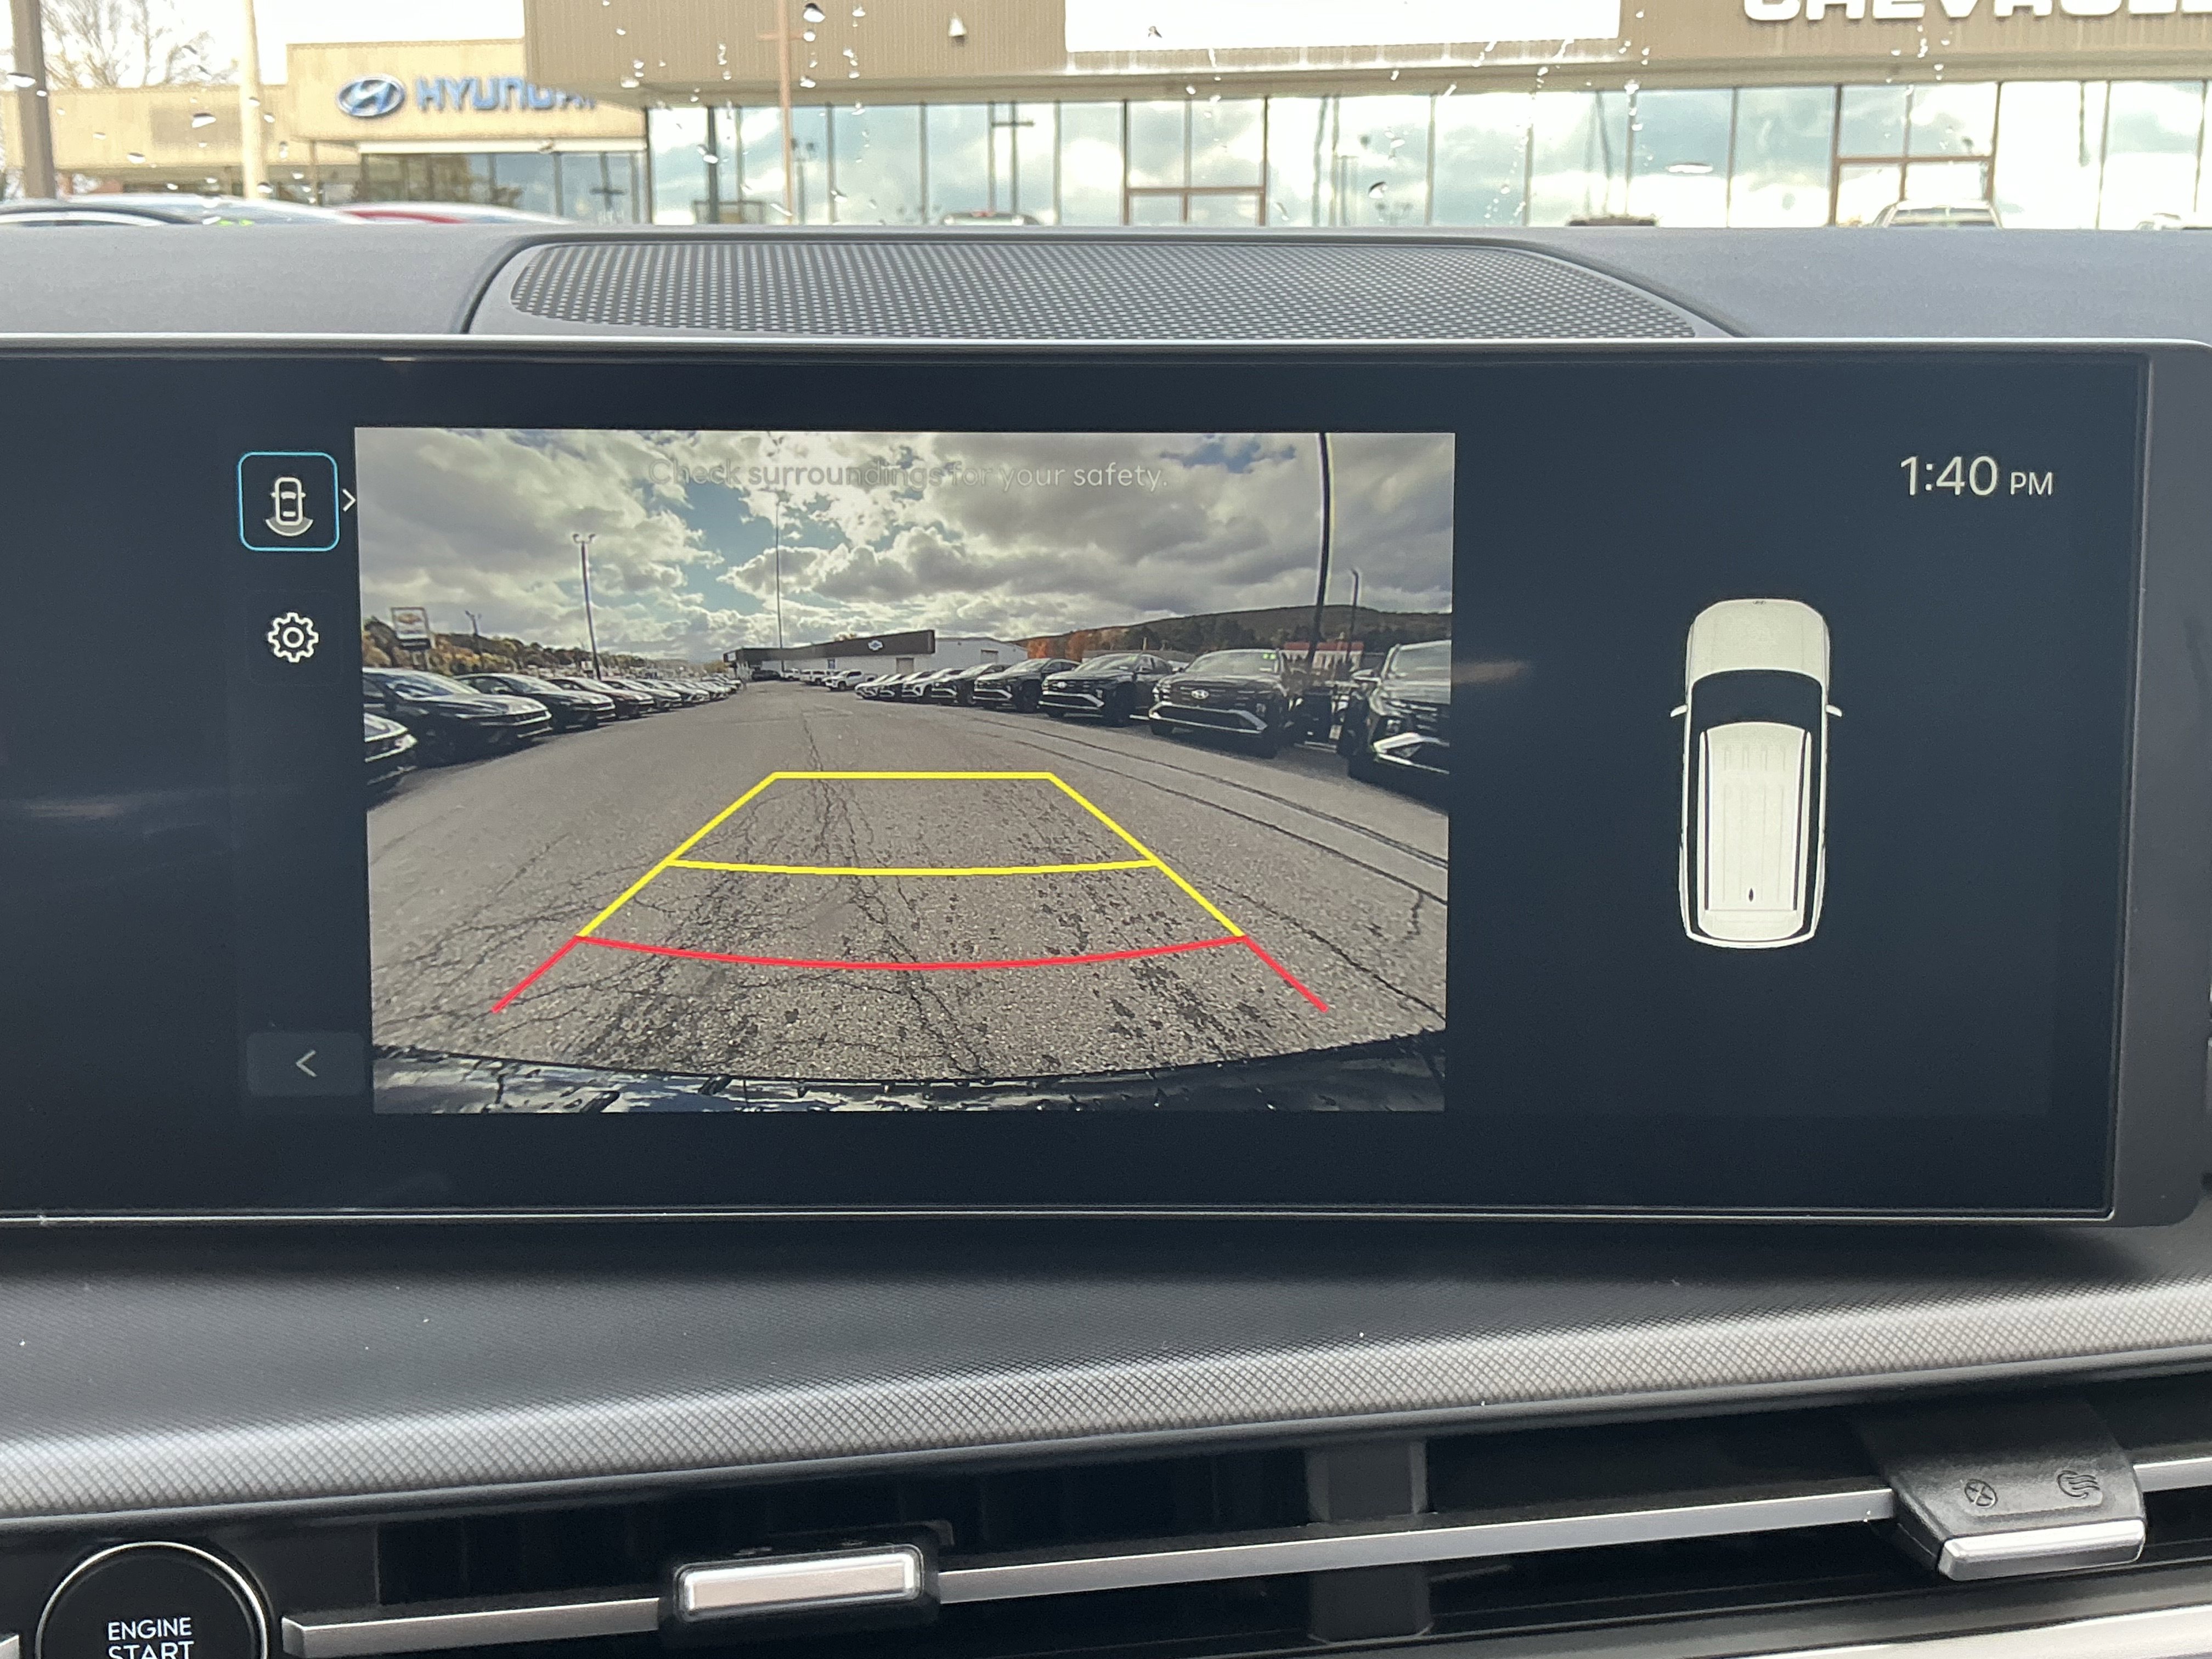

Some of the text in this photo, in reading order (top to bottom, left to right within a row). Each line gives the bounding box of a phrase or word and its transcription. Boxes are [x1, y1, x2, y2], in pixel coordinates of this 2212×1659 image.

[417, 75, 596, 111] HYUND
[649, 458, 1168, 492] Check surroundings for your safety.
[1900, 455, 2053, 495] 1:40 PM
[108, 1616, 193, 1641] ENGINE
[108, 1640, 195, 1659] START
